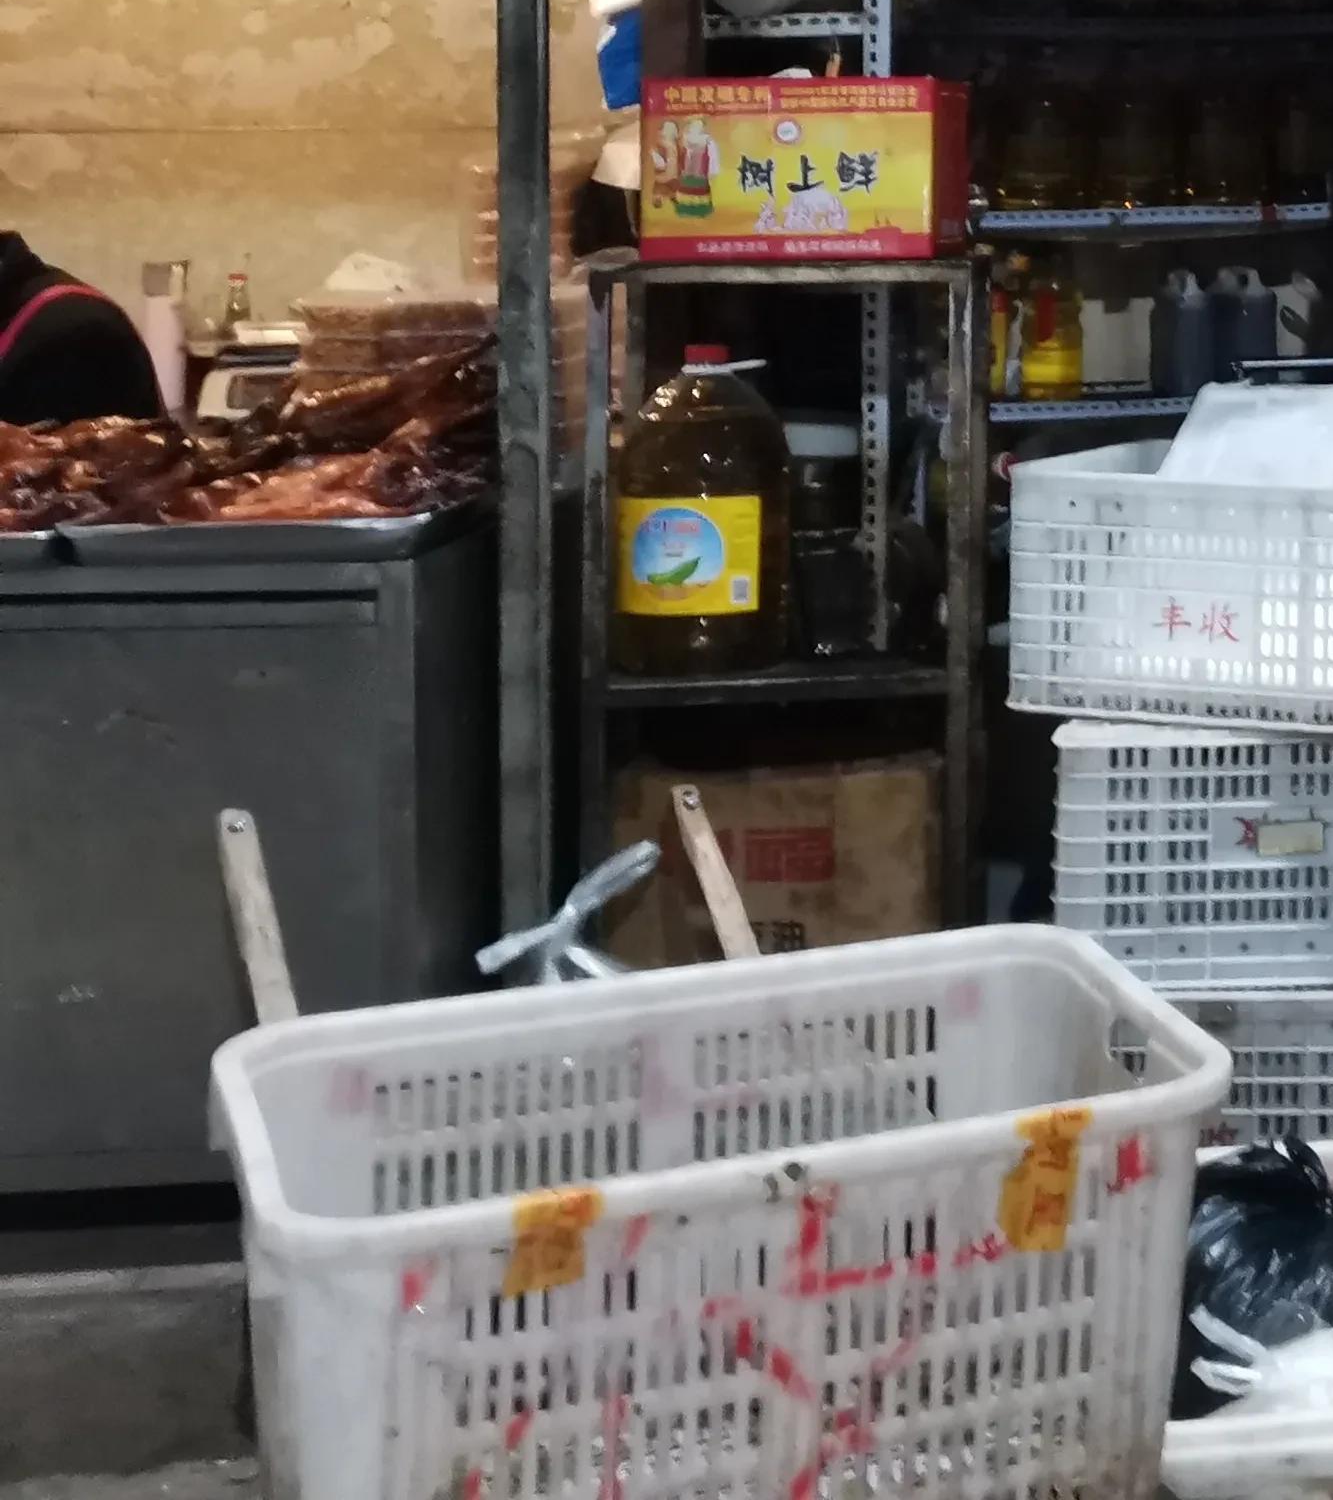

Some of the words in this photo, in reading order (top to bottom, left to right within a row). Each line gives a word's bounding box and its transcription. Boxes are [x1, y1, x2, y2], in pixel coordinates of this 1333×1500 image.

[737, 151, 879, 195] 树上鲜
[1152, 595, 1240, 643] 丰收
